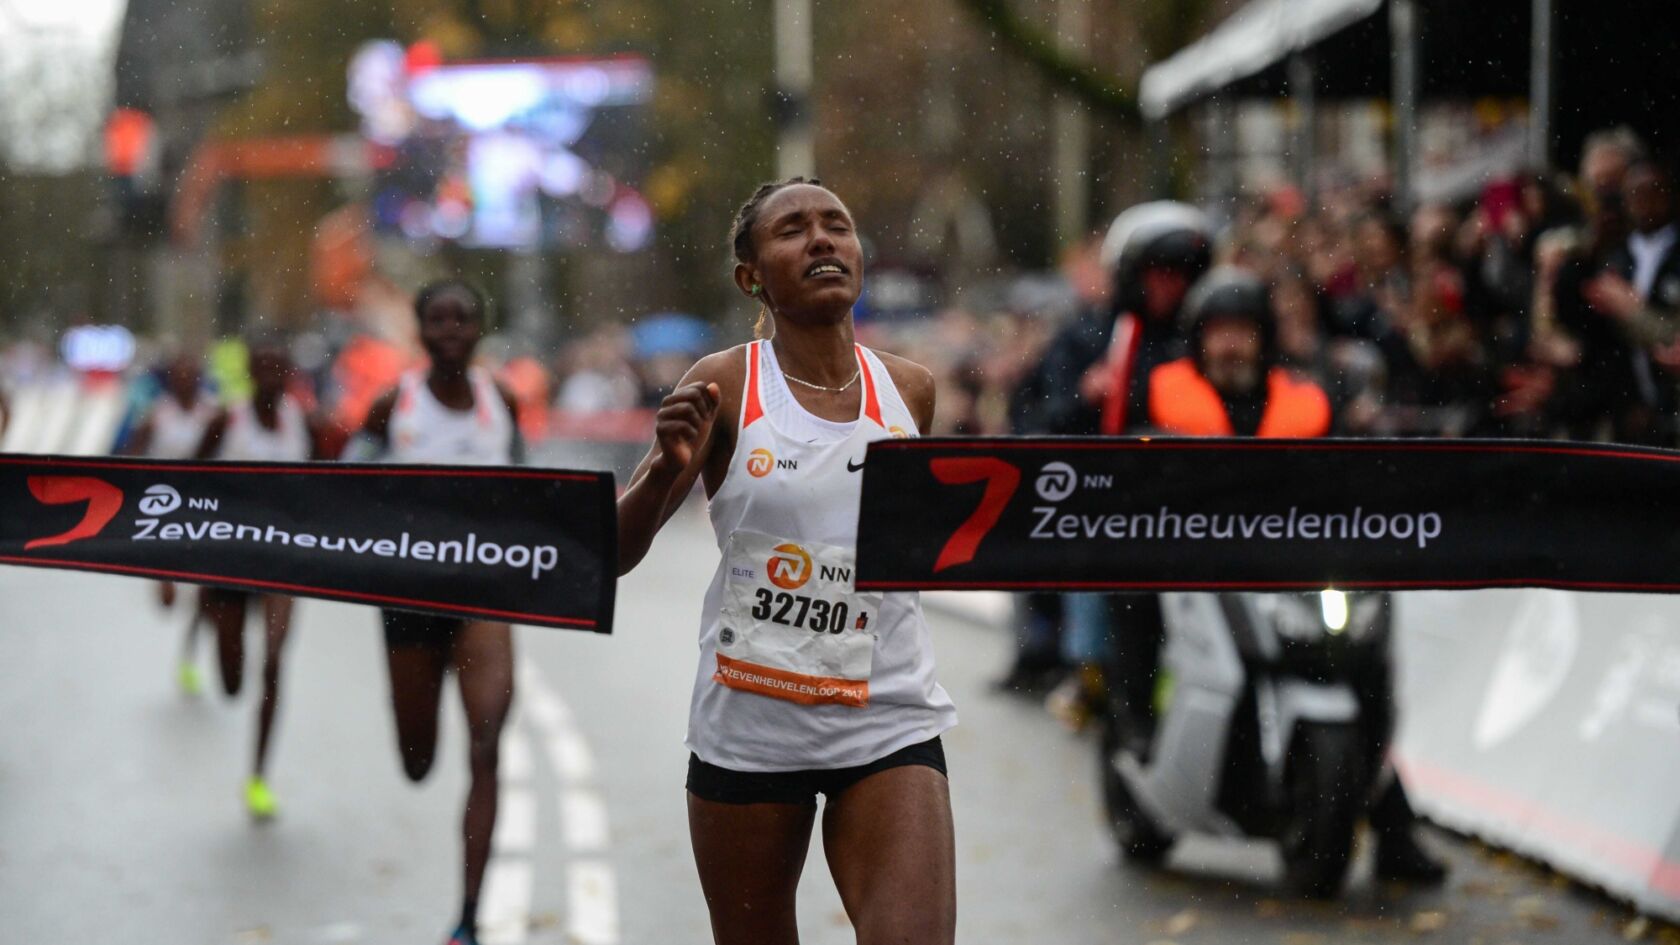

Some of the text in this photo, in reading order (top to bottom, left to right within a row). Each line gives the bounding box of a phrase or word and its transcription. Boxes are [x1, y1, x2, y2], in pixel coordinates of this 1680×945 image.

[777, 459, 798, 470] NN
[1083, 474, 1113, 489] NN
[188, 497, 219, 512] NN
[1029, 506, 1443, 548] Zevenheuvelenloop
[131, 517, 558, 580] Zevenheuvelenloop
[732, 567, 755, 578] ELITE
[820, 565, 851, 582] NN
[751, 587, 849, 634] 32730
[728, 669, 841, 697] ZEVENHEUVELENLOOP
